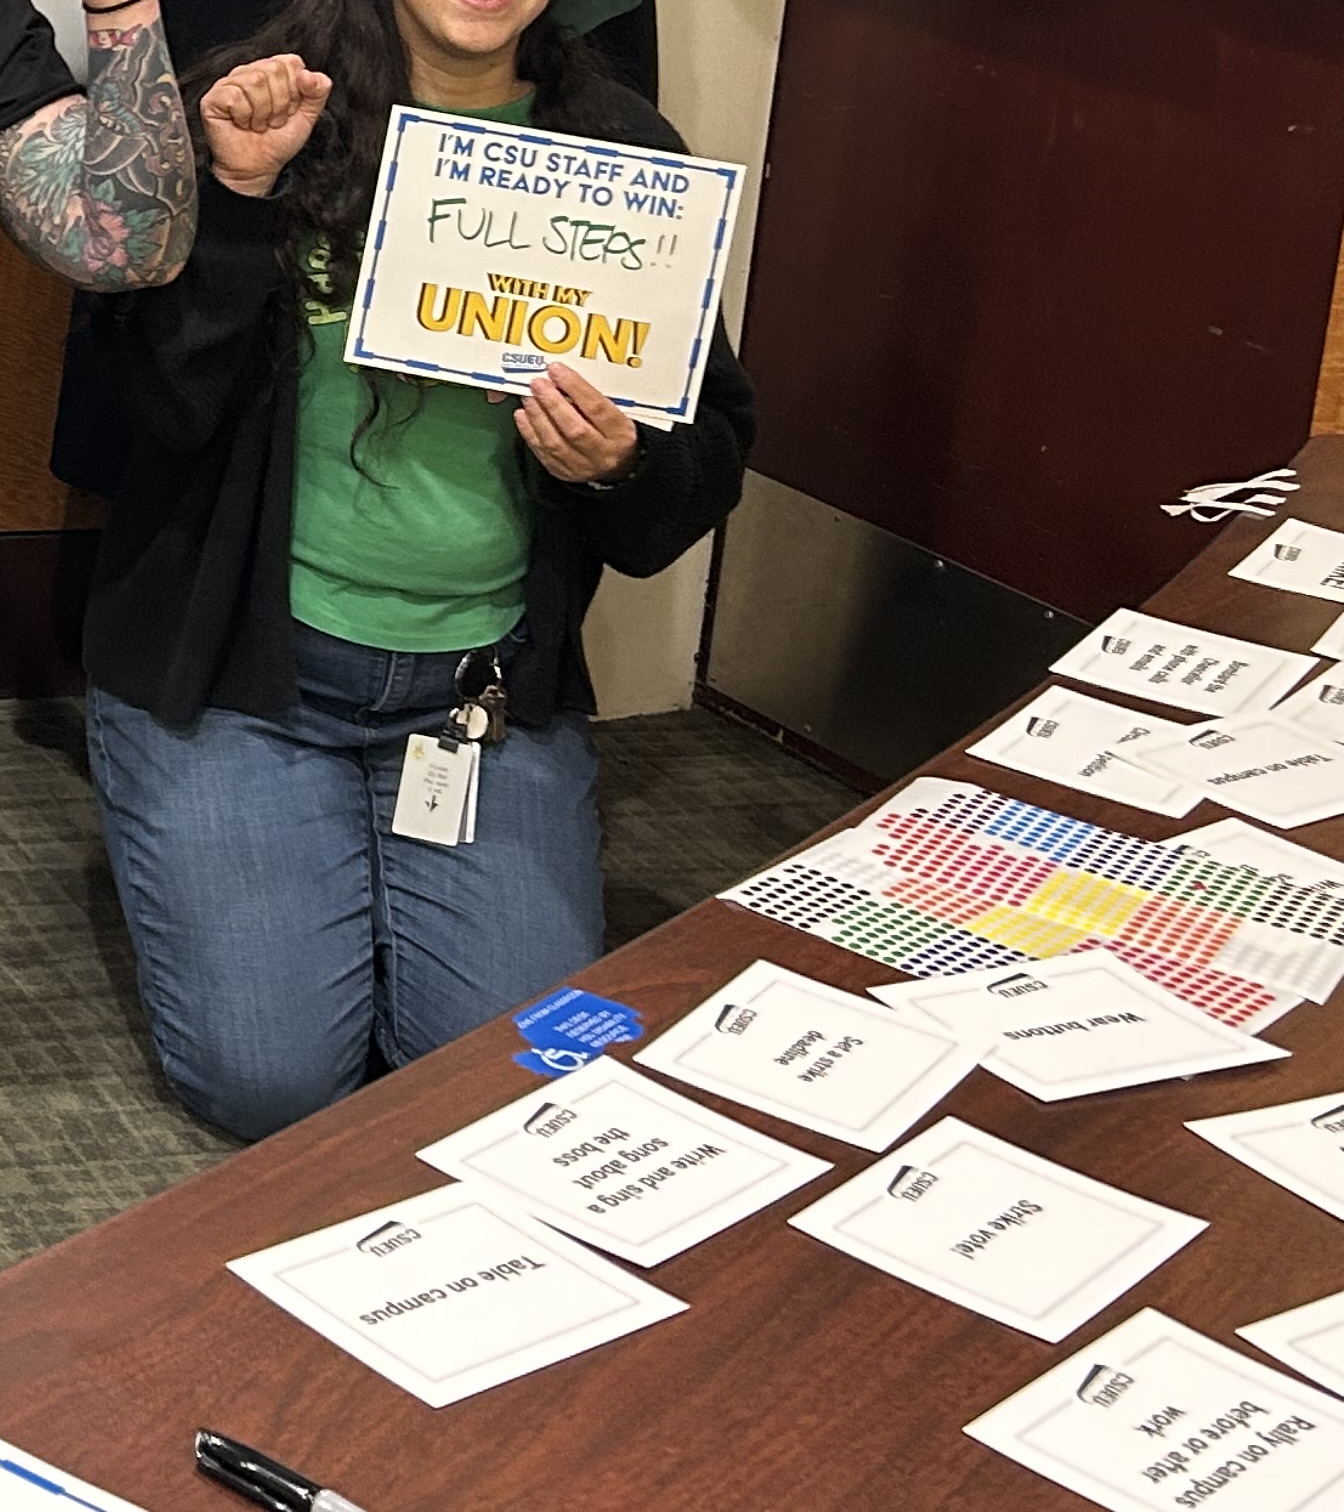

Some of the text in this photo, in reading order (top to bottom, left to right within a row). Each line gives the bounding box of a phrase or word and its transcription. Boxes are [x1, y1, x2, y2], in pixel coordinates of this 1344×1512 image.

[434, 157, 684, 220] I'M READY TO WIN:
[438, 133, 689, 193] I'M CSU STAFF AND
[428, 198, 678, 270] FULL STEPS!!
[487, 273, 593, 306] WITH MY
[417, 282, 651, 368] UNION!
[1002, 1012, 1147, 1041] Wear buttons
[553, 1127, 630, 1167] the boss
[572, 1138, 669, 1189] song about
[587, 1143, 727, 1214] Write and sing a
[950, 1199, 1043, 1260] Strike vote!
[359, 1255, 547, 1325] Table on campus
[1133, 1405, 1187, 1438] work
[1141, 1400, 1271, 1484] before or after
[1175, 1415, 1317, 1509] Rally on campus
